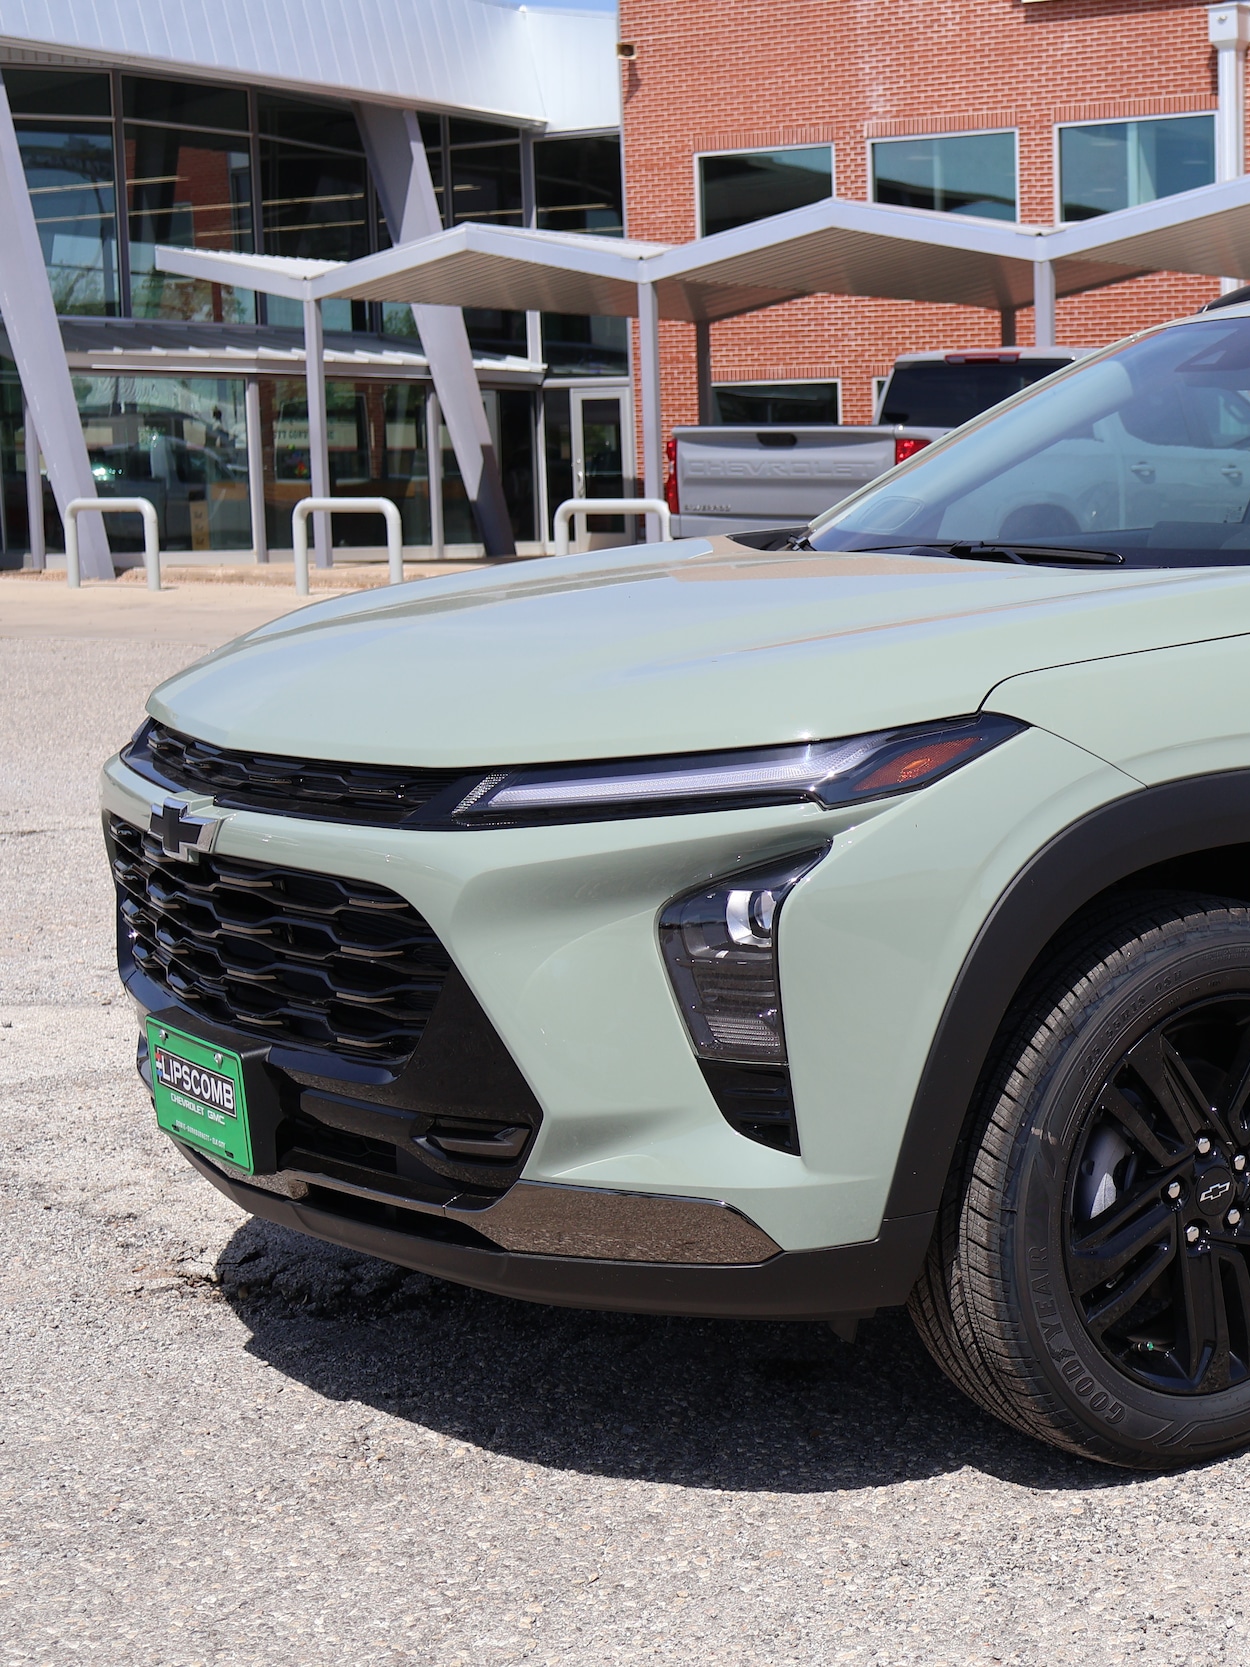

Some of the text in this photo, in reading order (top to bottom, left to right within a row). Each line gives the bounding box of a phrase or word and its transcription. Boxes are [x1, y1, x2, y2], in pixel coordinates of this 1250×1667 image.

[687, 460, 877, 477] CHEVROLET
[161, 1054, 234, 1110] LIPSCOMB
[170, 1092, 226, 1126] CHEVROLET GMC
[1027, 1246, 1126, 1425] GOODYEAR
